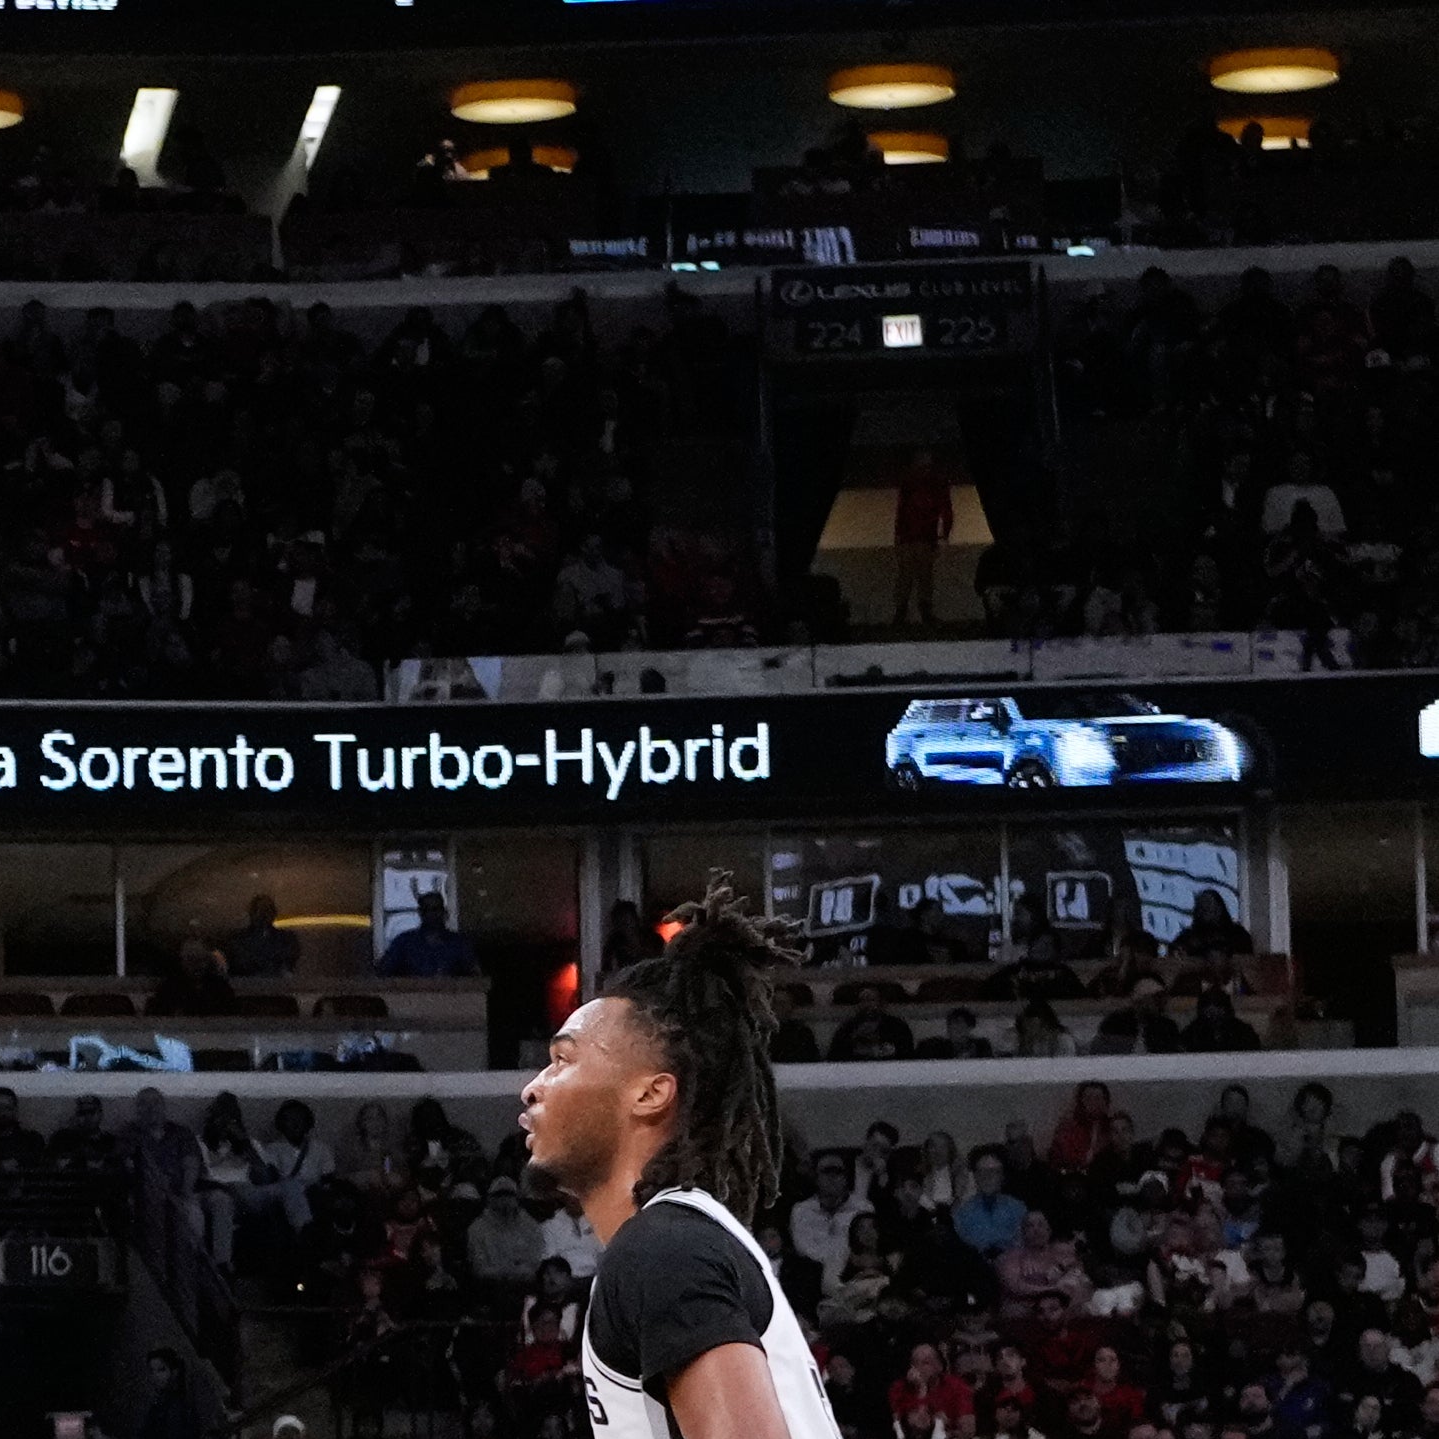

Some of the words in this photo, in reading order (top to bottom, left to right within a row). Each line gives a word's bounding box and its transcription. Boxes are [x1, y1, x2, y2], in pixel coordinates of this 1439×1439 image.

[39, 729, 294, 792] Sorento
[313, 722, 770, 801] Turbo-Hybrid
[31, 1245, 71, 1276] 116
